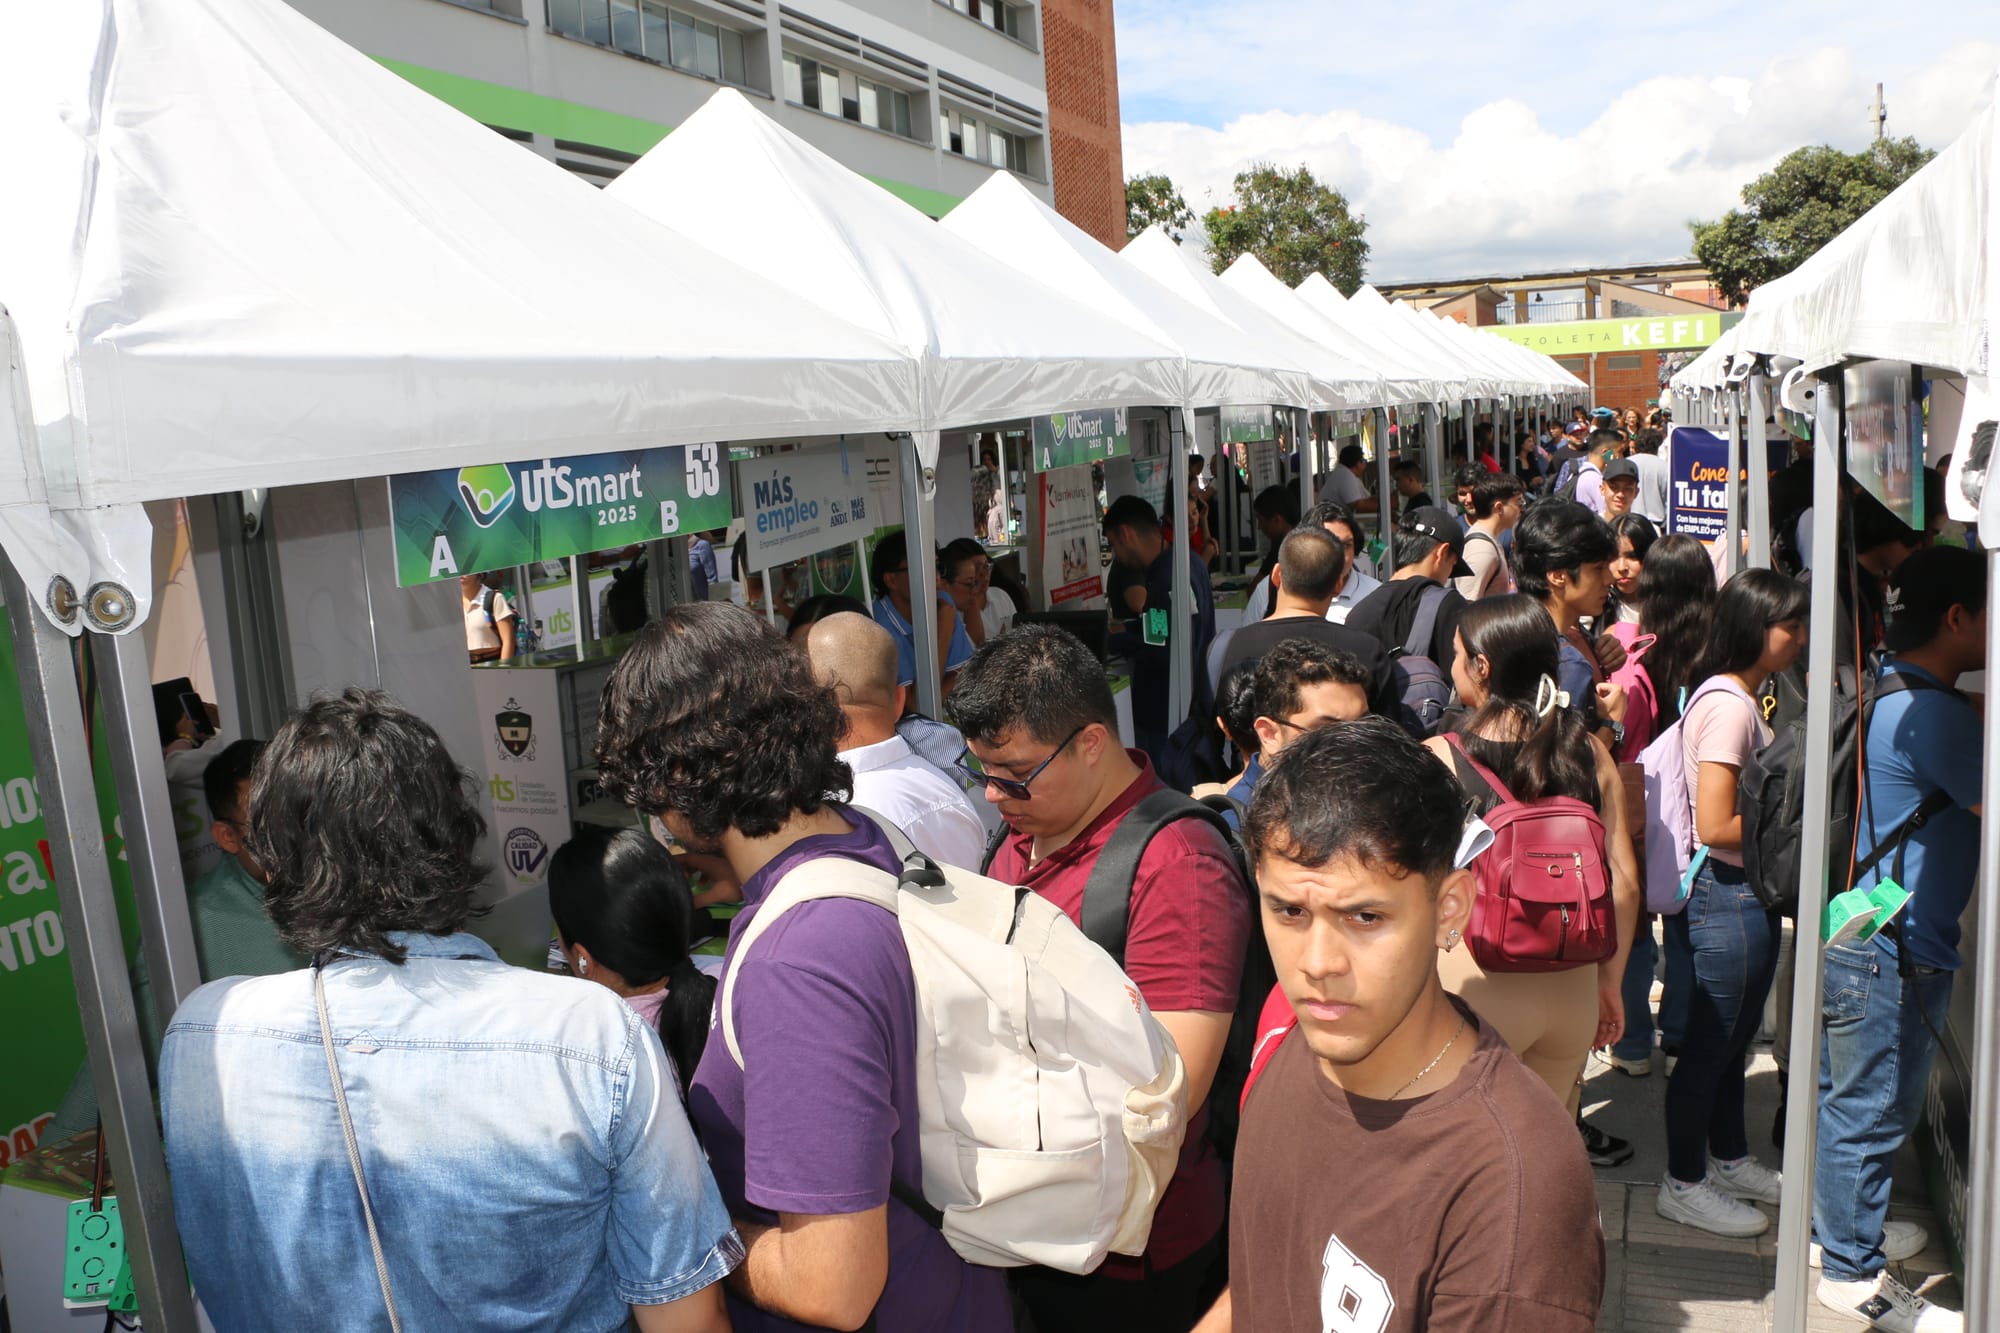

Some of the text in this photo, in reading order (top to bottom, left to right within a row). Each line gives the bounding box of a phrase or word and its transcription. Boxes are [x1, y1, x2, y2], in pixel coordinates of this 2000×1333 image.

[1508, 320, 1704, 346] ZOLETA KEFI
[1043, 447, 1052, 468] A
[1107, 436, 1114, 455] B
[685, 442, 720, 499] 53
[754, 470, 793, 509] MÁS
[1675, 481, 1728, 508] Tu tal
[598, 505, 637, 526] 2025
[660, 500, 679, 534] B
[757, 501, 818, 533] empleo
[830, 512, 848, 527] ANDI
[1676, 515, 1688, 523] Con
[1689, 515, 1698, 523] las
[1699, 516, 1723, 526] mejores
[1684, 525, 1710, 535] EMPLEO
[429, 535, 458, 577] A
